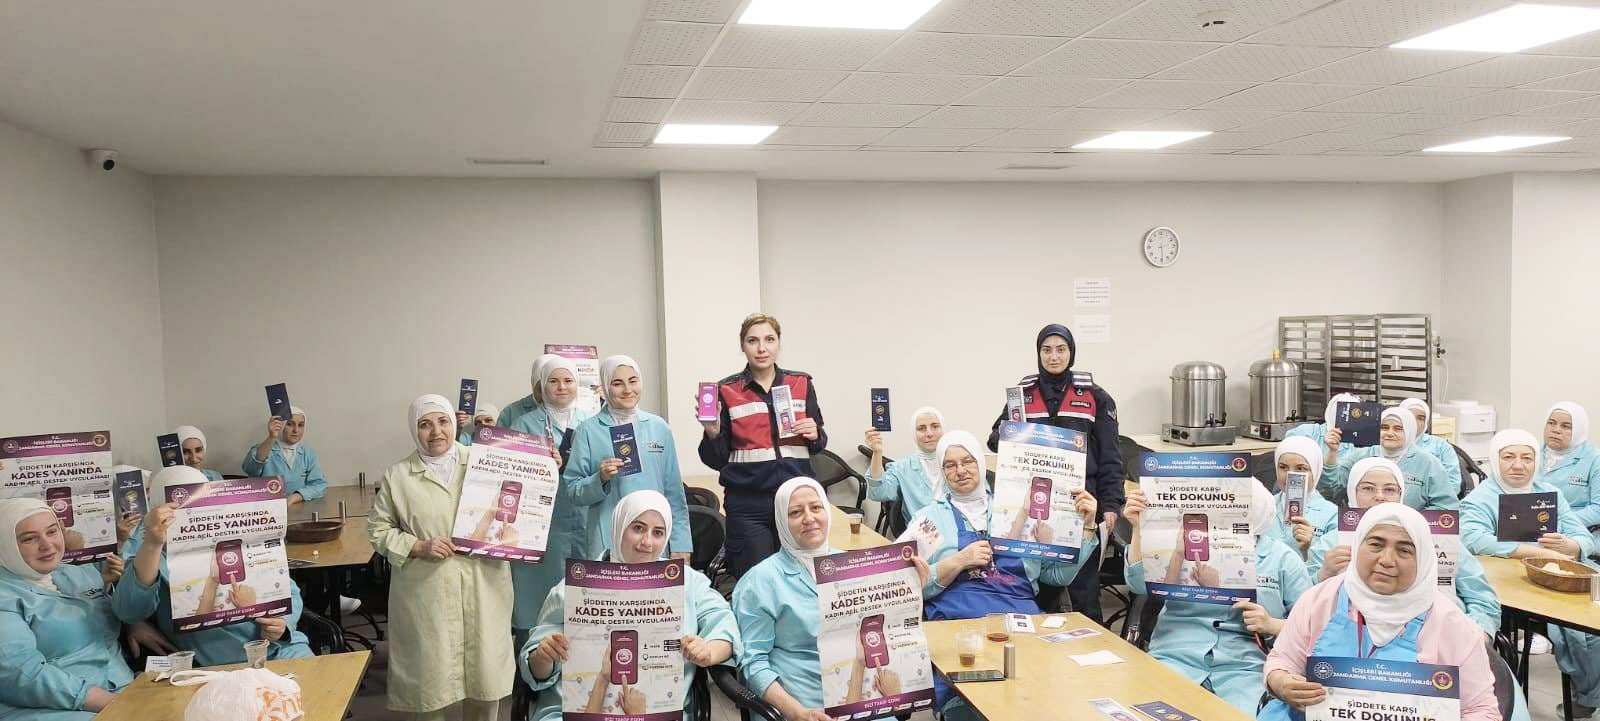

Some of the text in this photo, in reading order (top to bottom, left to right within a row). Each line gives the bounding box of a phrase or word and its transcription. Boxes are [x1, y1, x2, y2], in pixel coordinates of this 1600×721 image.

[479, 459, 552, 478] KADES YANINDA
[1033, 459, 1075, 472] DOKUNUŞ
[11, 467, 102, 481] KADES YANINDA
[1156, 493, 1236, 504] TEK DOKUNUŞ
[181, 517, 277, 534] KADES YANINDA
[831, 587, 913, 611] KADES YANINDA
[576, 607, 673, 617] KADES YANINDA
[1329, 708, 1357, 720] TEK
[1348, 700, 1417, 715] ŞİDDETE KARŞI
